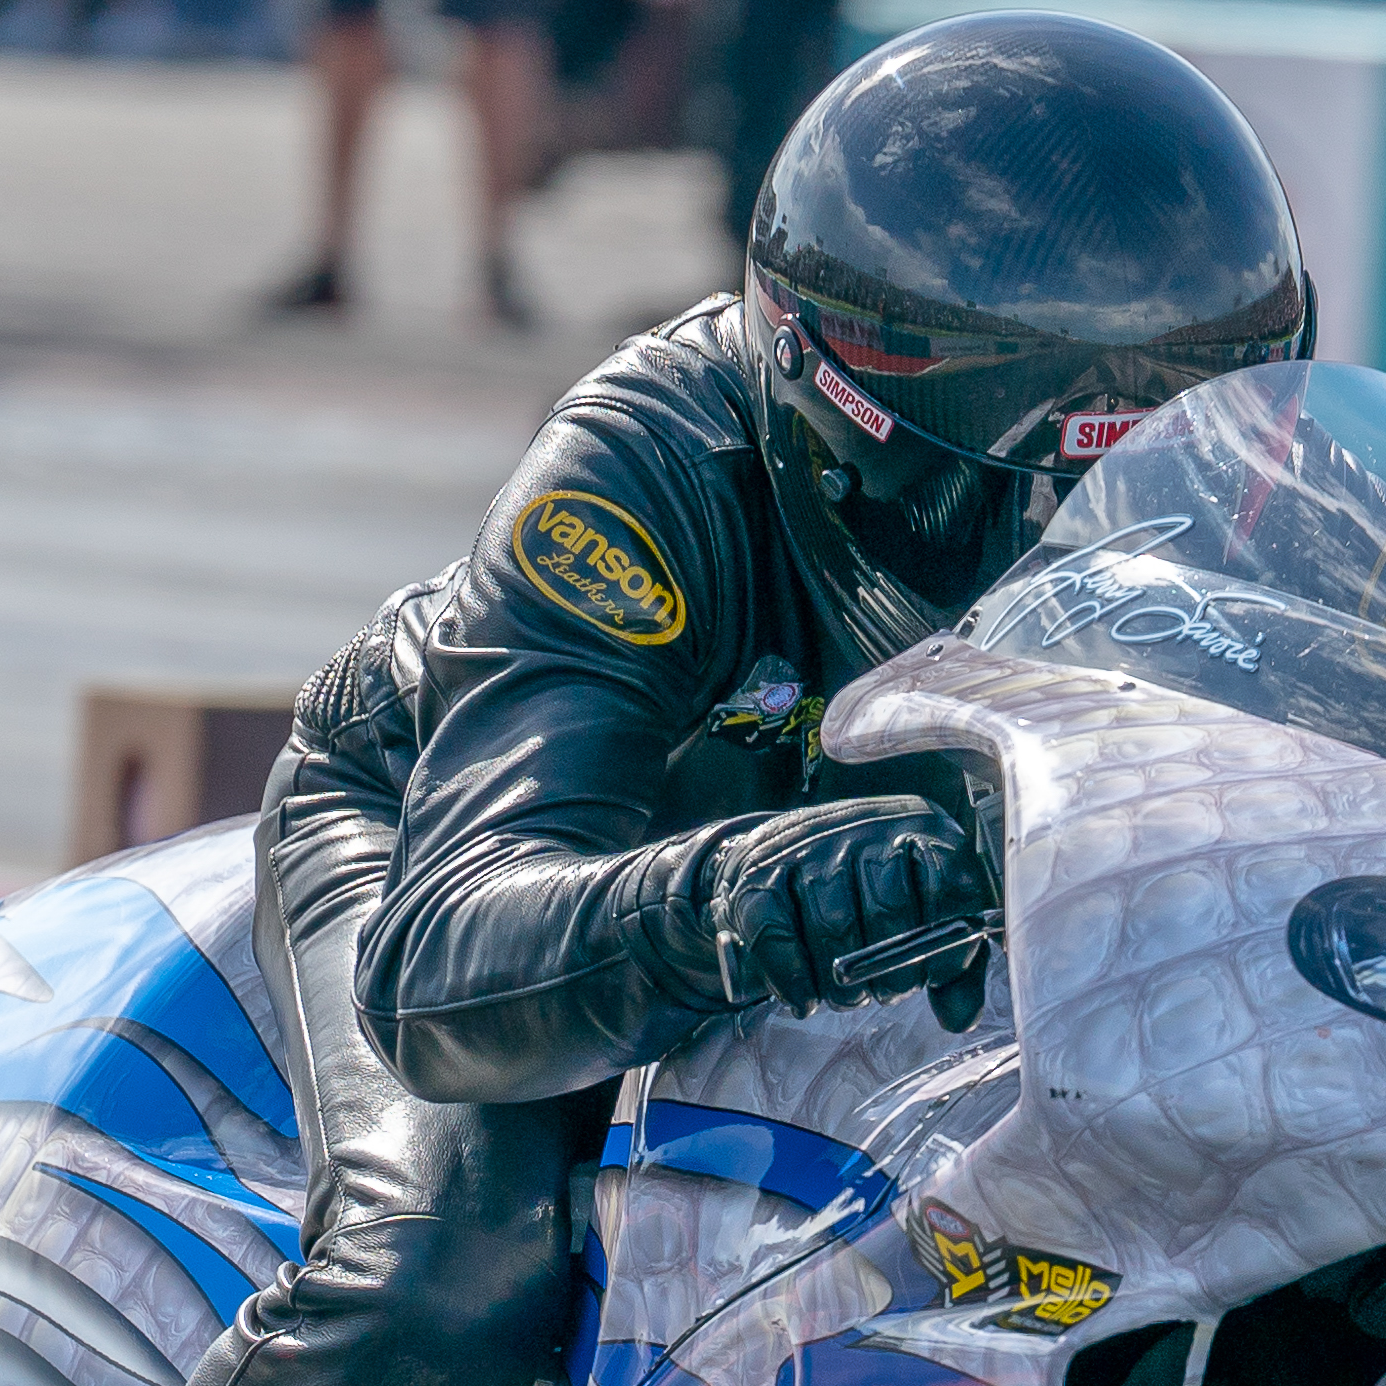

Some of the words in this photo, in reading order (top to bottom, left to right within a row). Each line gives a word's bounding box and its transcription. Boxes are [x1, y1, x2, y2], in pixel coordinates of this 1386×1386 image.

[820, 369, 885, 434] SIMPSON
[537, 502, 675, 624] vanson
[537, 553, 624, 625] Leathers
[1016, 1255, 1112, 1308] Mello
